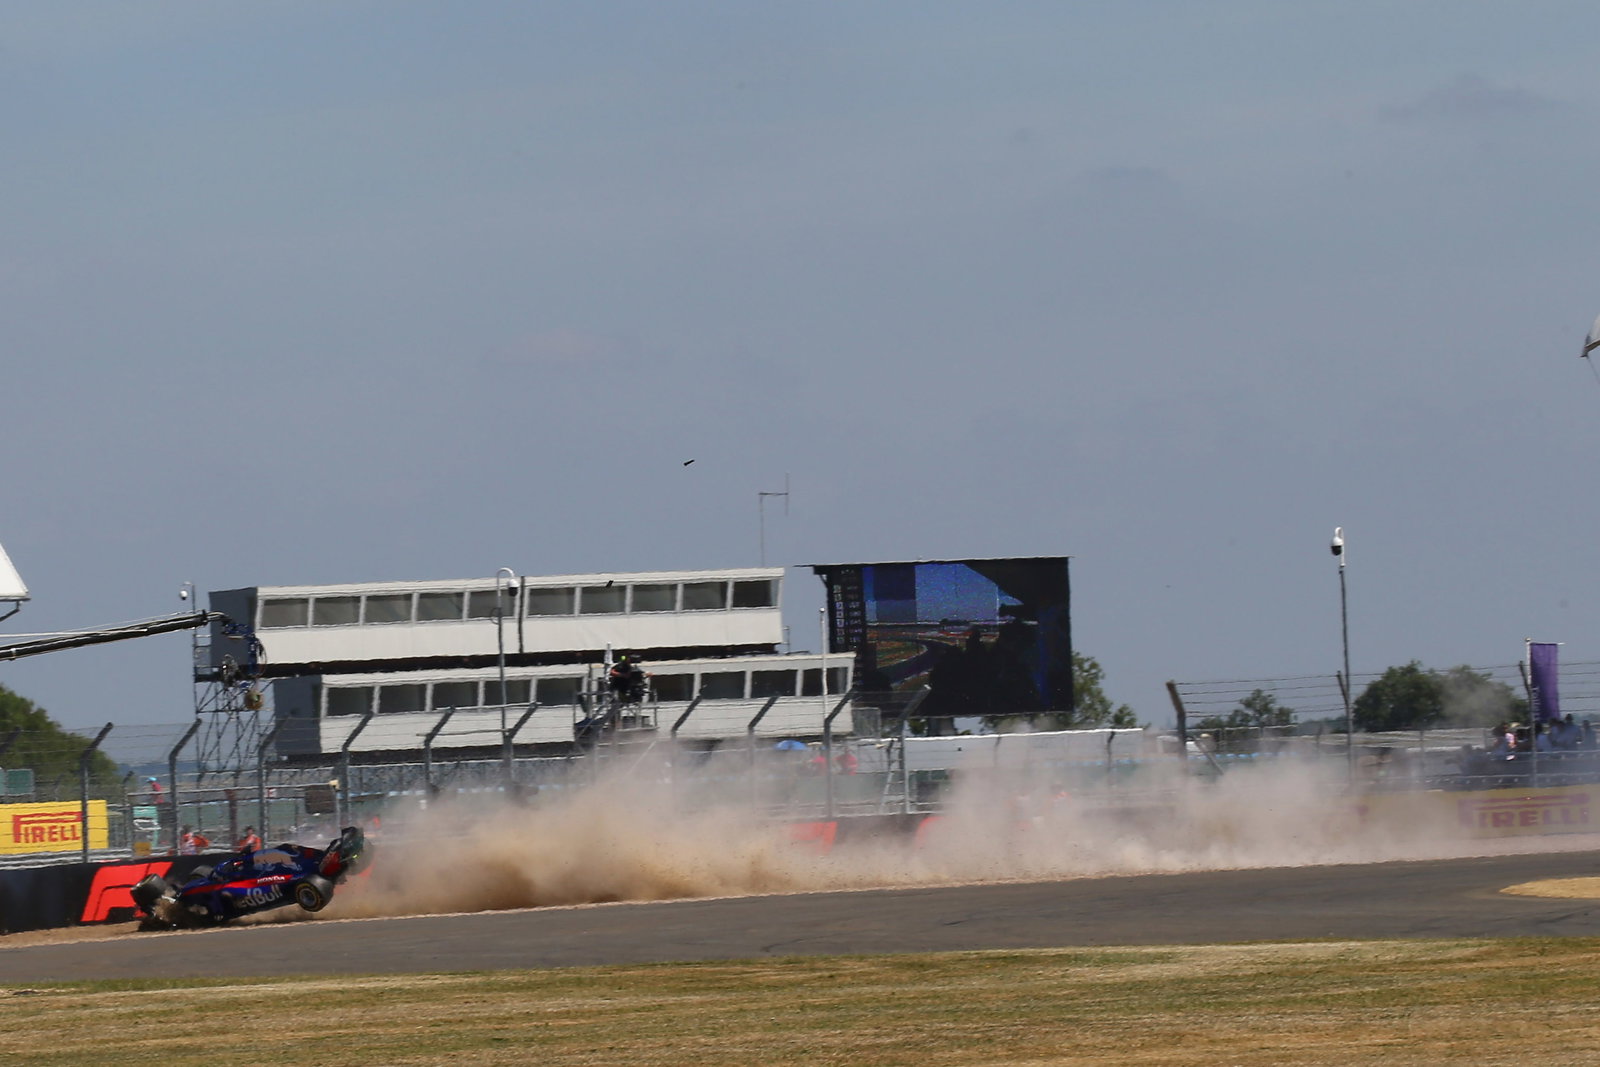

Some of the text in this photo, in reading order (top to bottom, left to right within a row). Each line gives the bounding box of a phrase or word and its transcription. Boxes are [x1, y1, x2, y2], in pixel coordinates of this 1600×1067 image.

[1457, 792, 1591, 829] PIRELLI
[12, 811, 83, 843] PIRELL
[257, 875, 285, 884] HONDA
[237, 884, 283, 908] edBull
